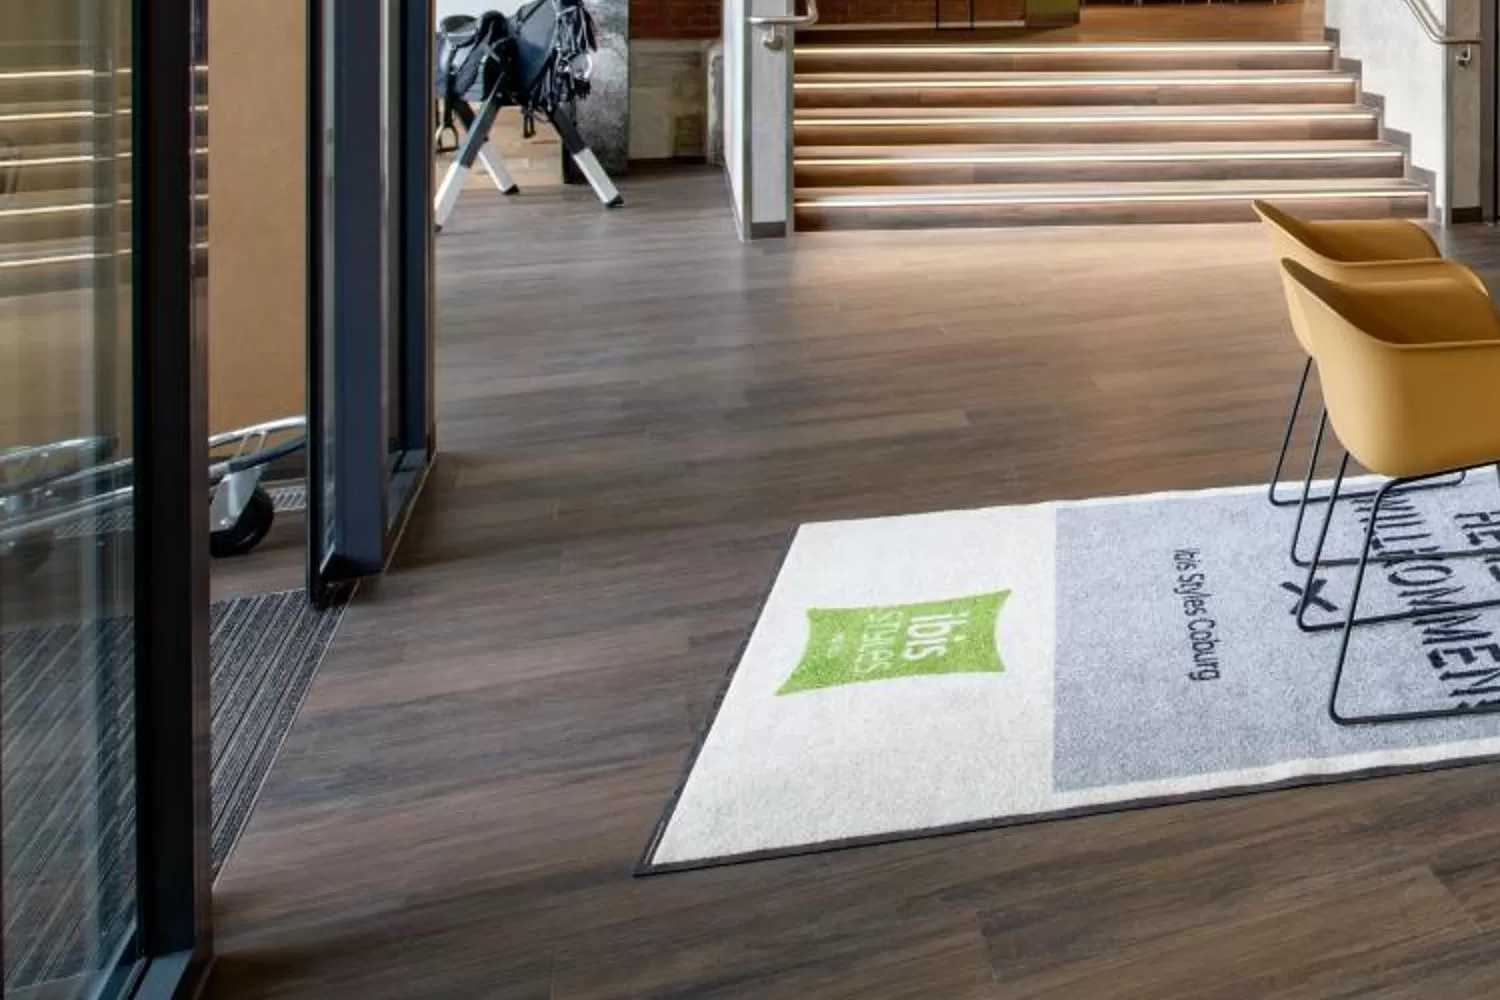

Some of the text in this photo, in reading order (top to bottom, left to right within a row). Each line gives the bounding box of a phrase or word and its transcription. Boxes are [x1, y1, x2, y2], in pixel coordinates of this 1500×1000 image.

[1173, 573, 1213, 616] Styles
[902, 611, 972, 661] ibis
[1187, 617, 1222, 681] Coburg
